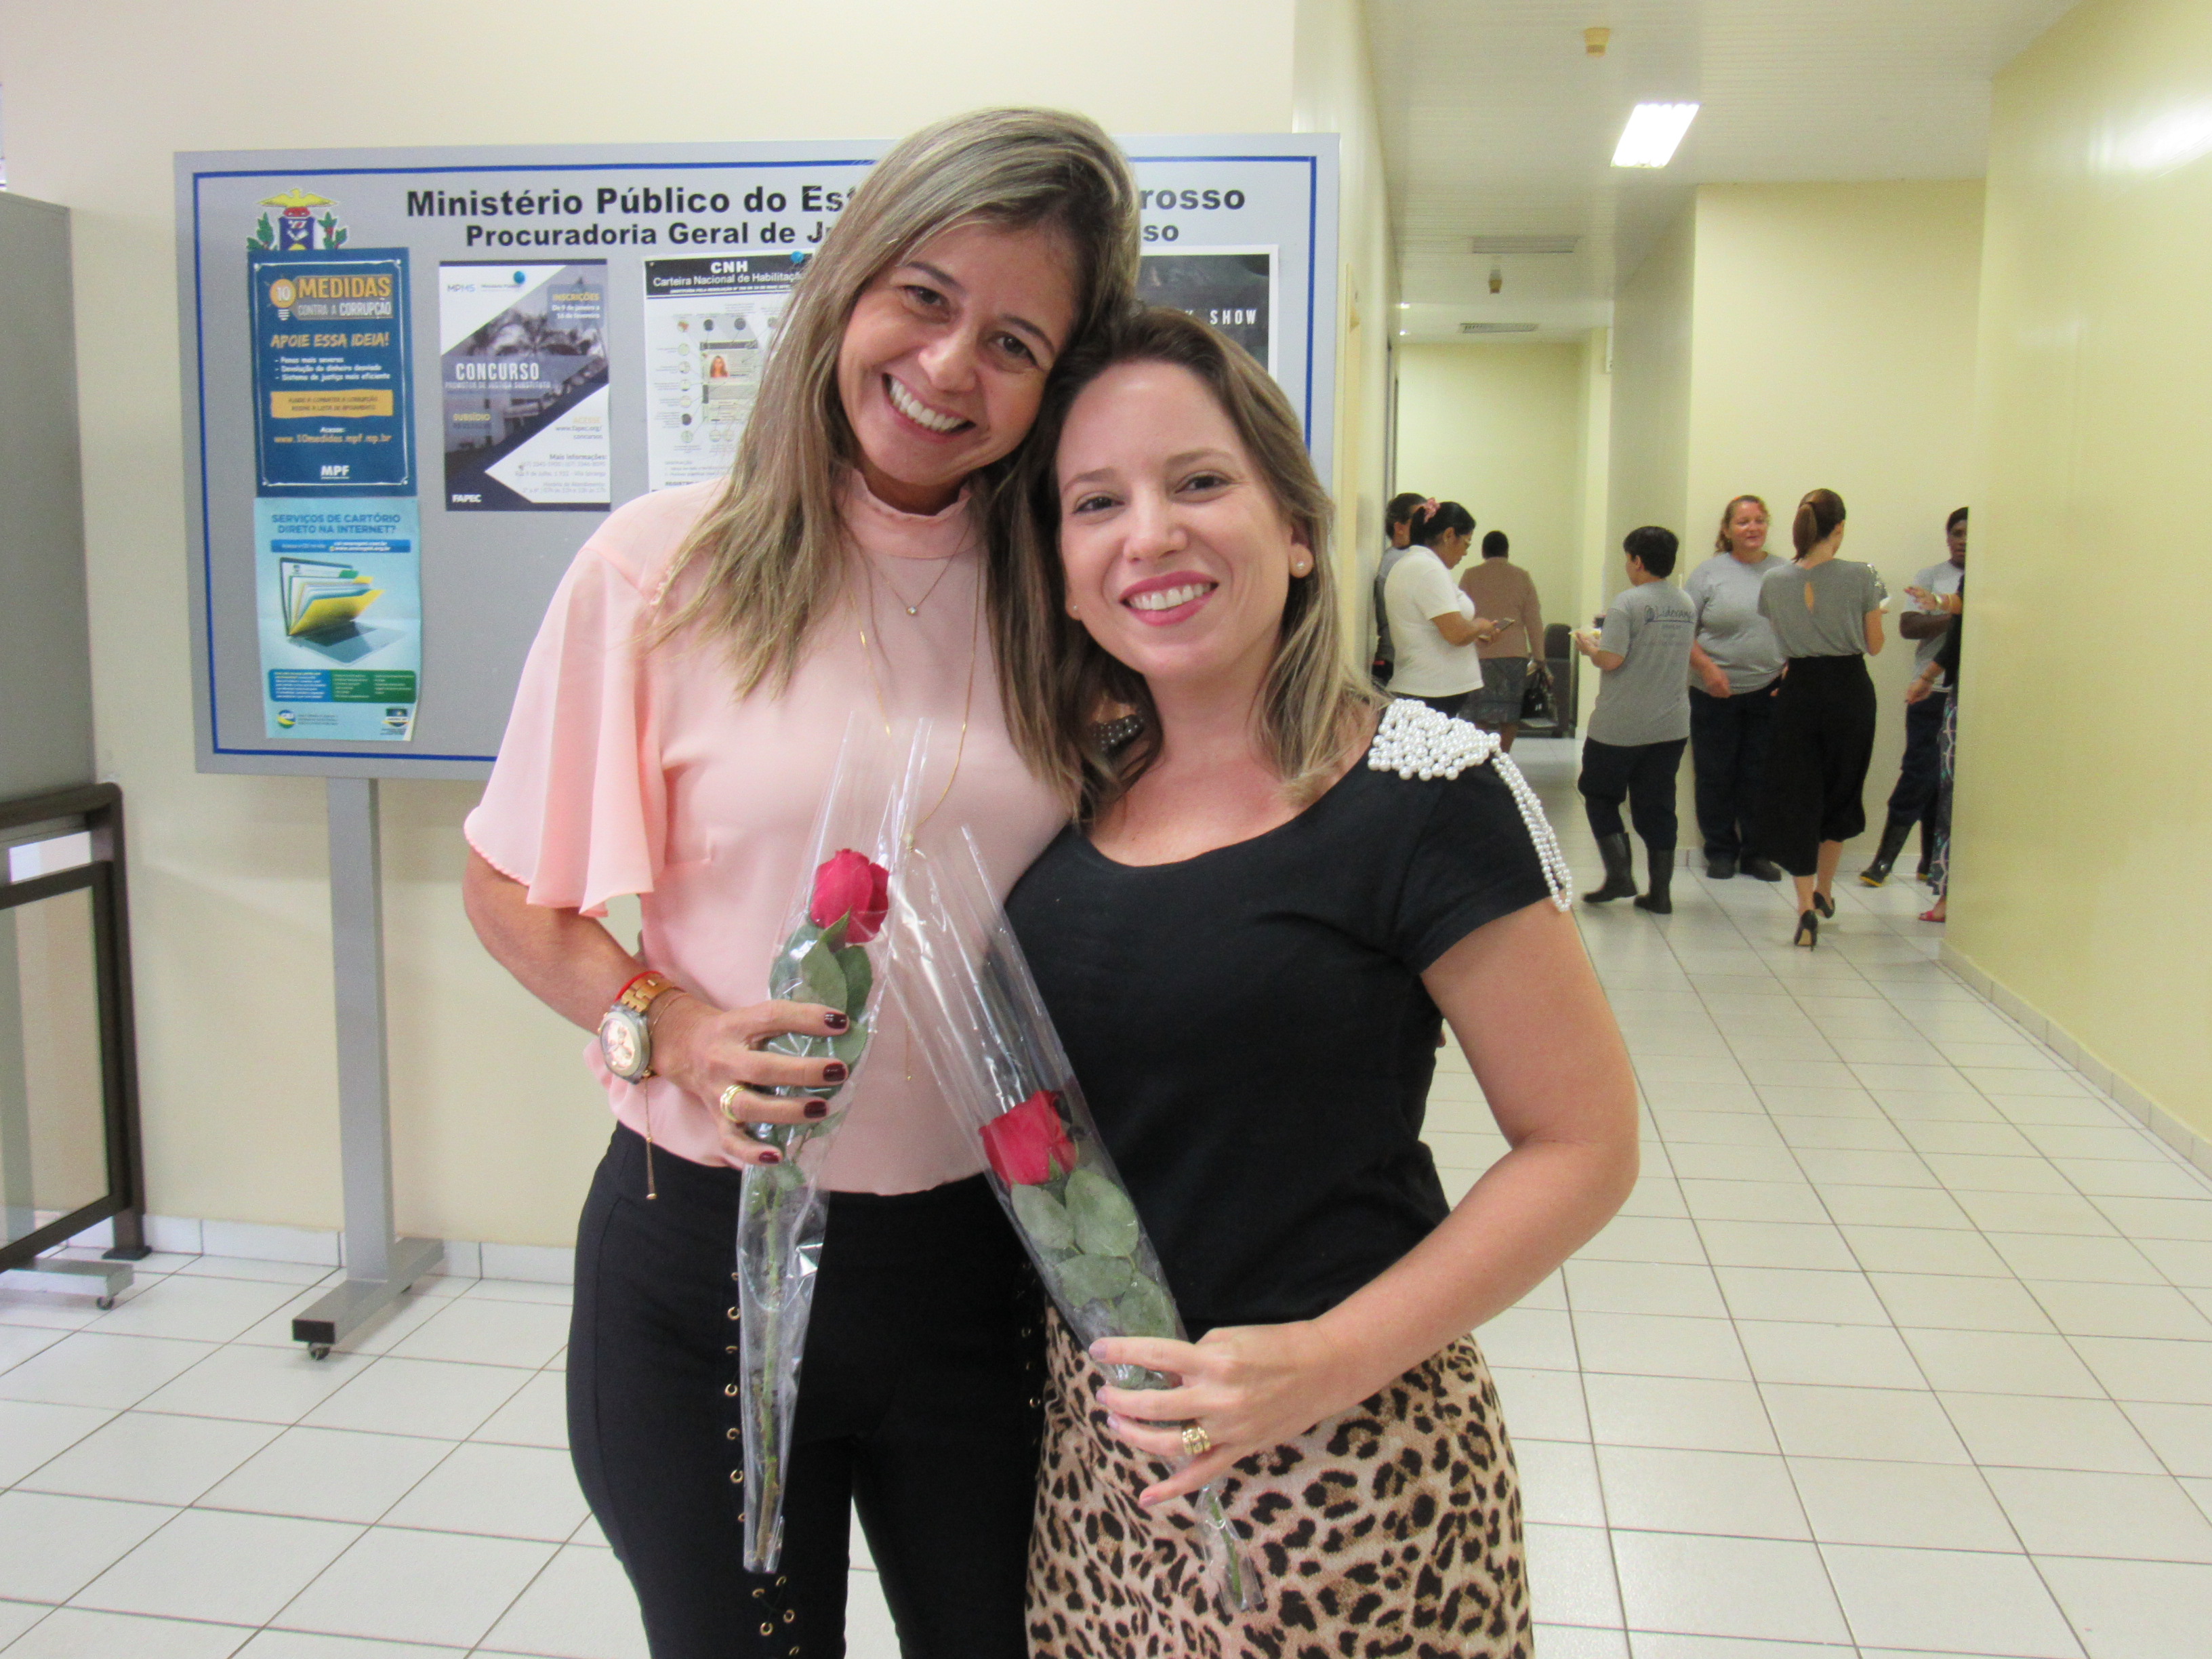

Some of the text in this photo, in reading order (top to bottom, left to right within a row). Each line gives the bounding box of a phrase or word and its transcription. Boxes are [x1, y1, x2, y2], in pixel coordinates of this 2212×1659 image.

[407, 189, 583, 216] Ministério
[597, 186, 730, 215] Público
[743, 186, 786, 213] do
[1140, 189, 1245, 210] rosso
[466, 223, 656, 247] Procuradoria
[669, 222, 748, 245] Geral
[760, 222, 796, 245] de
[1143, 224, 1179, 242] so
[711, 261, 748, 274] CNH
[299, 276, 392, 299] MEDIDAS
[653, 276, 692, 287] Carteira
[694, 274, 735, 285] Nacional
[737, 273, 750, 283] de
[277, 286, 292, 301] 10
[298, 297, 392, 319] CONTRA A CORRUPÇÃO
[1210, 309, 1257, 325] SHOW
[270, 332, 391, 349] APOIE ESSA IDEIA!
[456, 363, 539, 380] CONCURSO
[321, 465, 350, 476] MPF
[451, 493, 482, 502] FAPEC
[272, 512, 401, 524] SERVIÇOS DE CARTÓRIO
[278, 525, 396, 534] DIRETO NA INTERNET?
